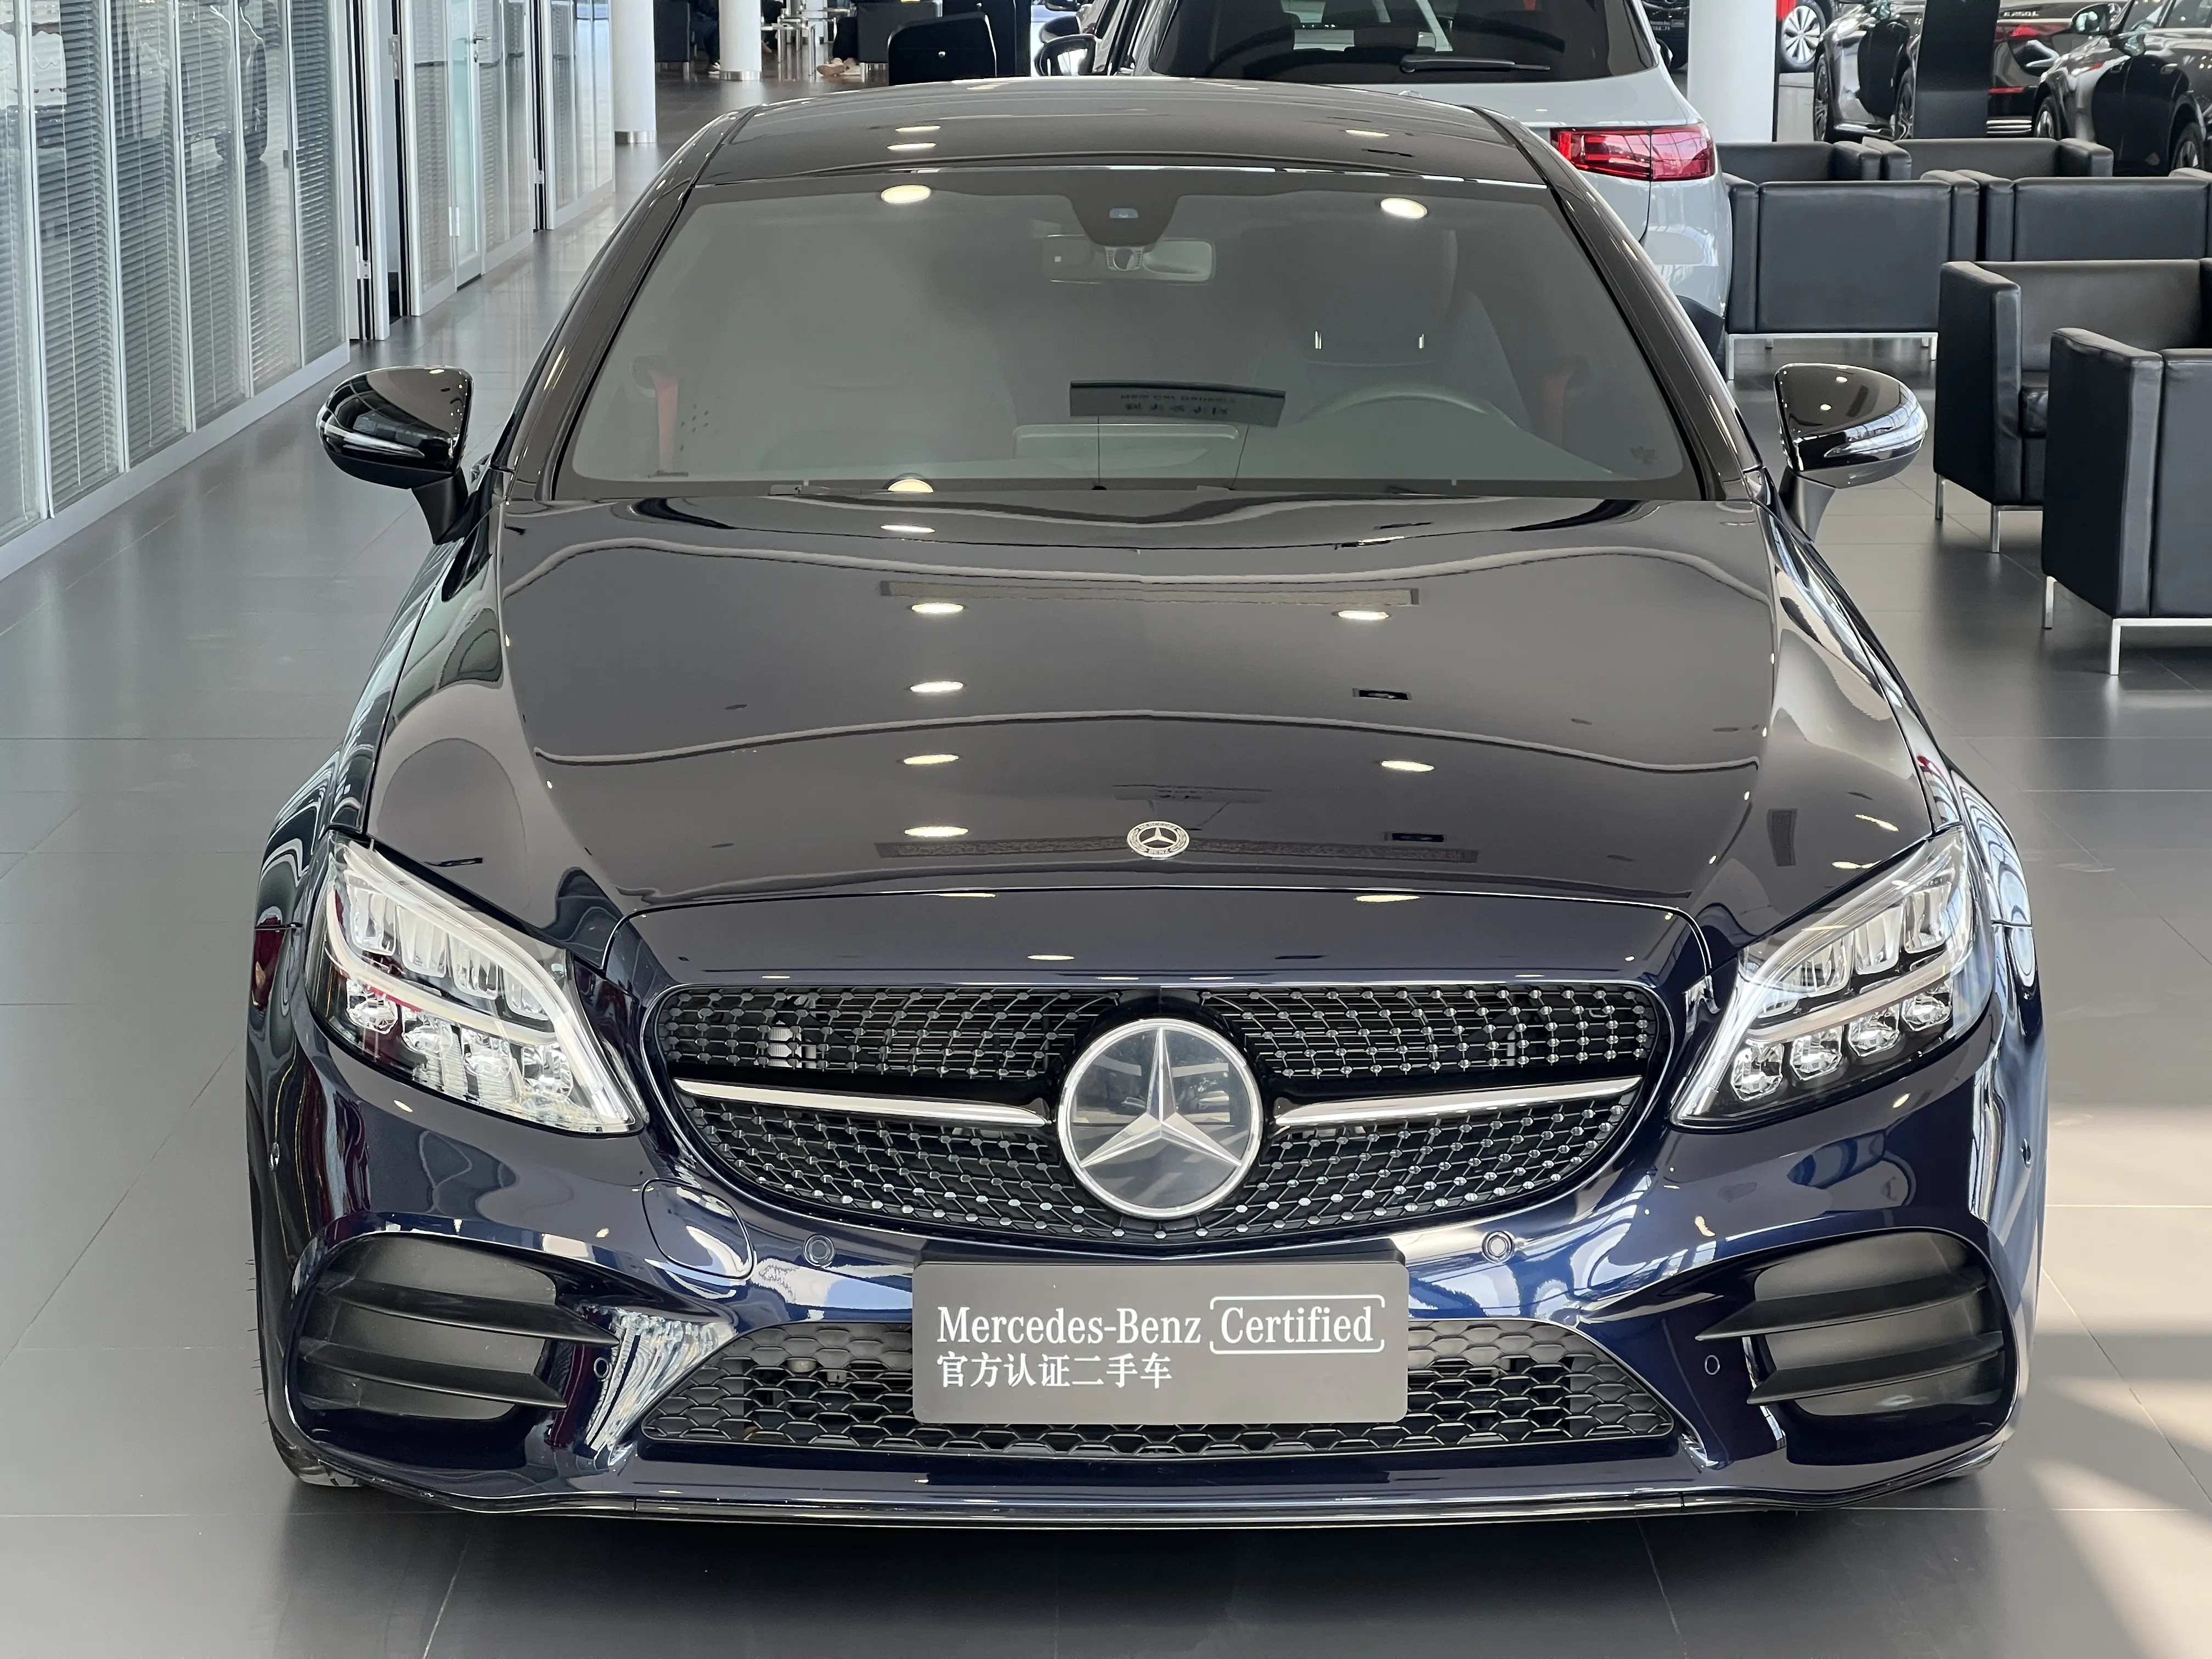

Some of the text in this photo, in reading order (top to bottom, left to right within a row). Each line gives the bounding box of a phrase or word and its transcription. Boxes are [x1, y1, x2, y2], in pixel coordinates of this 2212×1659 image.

[936, 1306, 1374, 1344] Mercedes-Benz Certified
[936, 1351, 1172, 1389] 官方认证二手车
